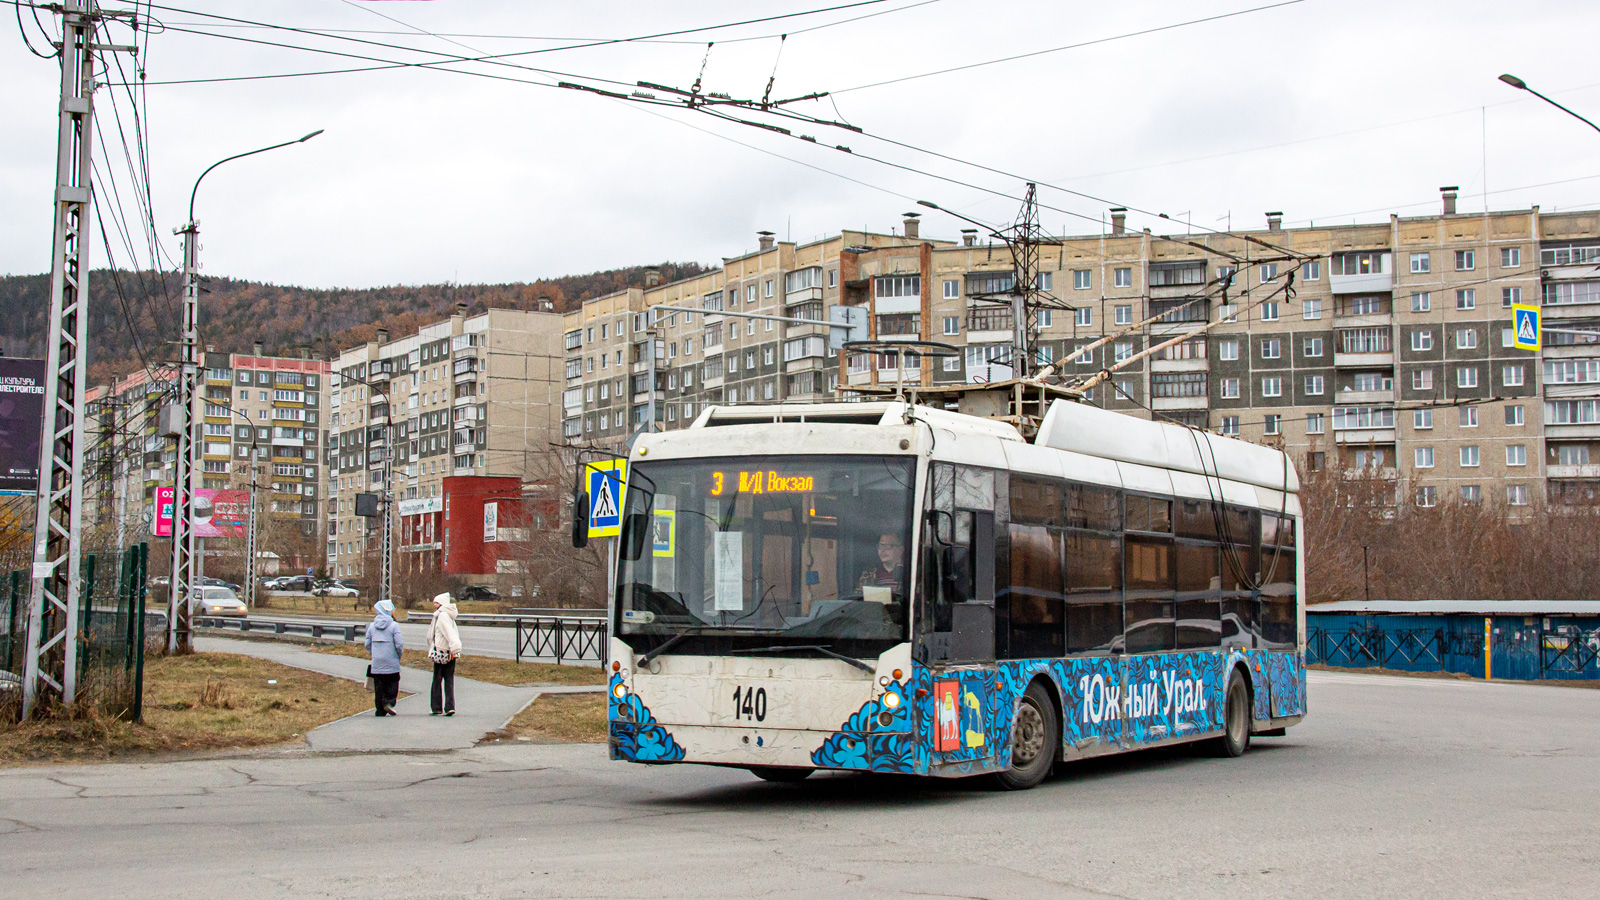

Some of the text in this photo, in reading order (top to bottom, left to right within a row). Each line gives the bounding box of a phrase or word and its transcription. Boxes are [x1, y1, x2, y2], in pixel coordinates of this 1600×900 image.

[5, 377, 36, 386] КУЛЬТУРЫ
[162, 490, 174, 498] OZ
[711, 470, 814, 496] 3 Ж/Д Вокзал
[733, 685, 767, 722] 140
[1080, 669, 1207, 726] Южный Урал
